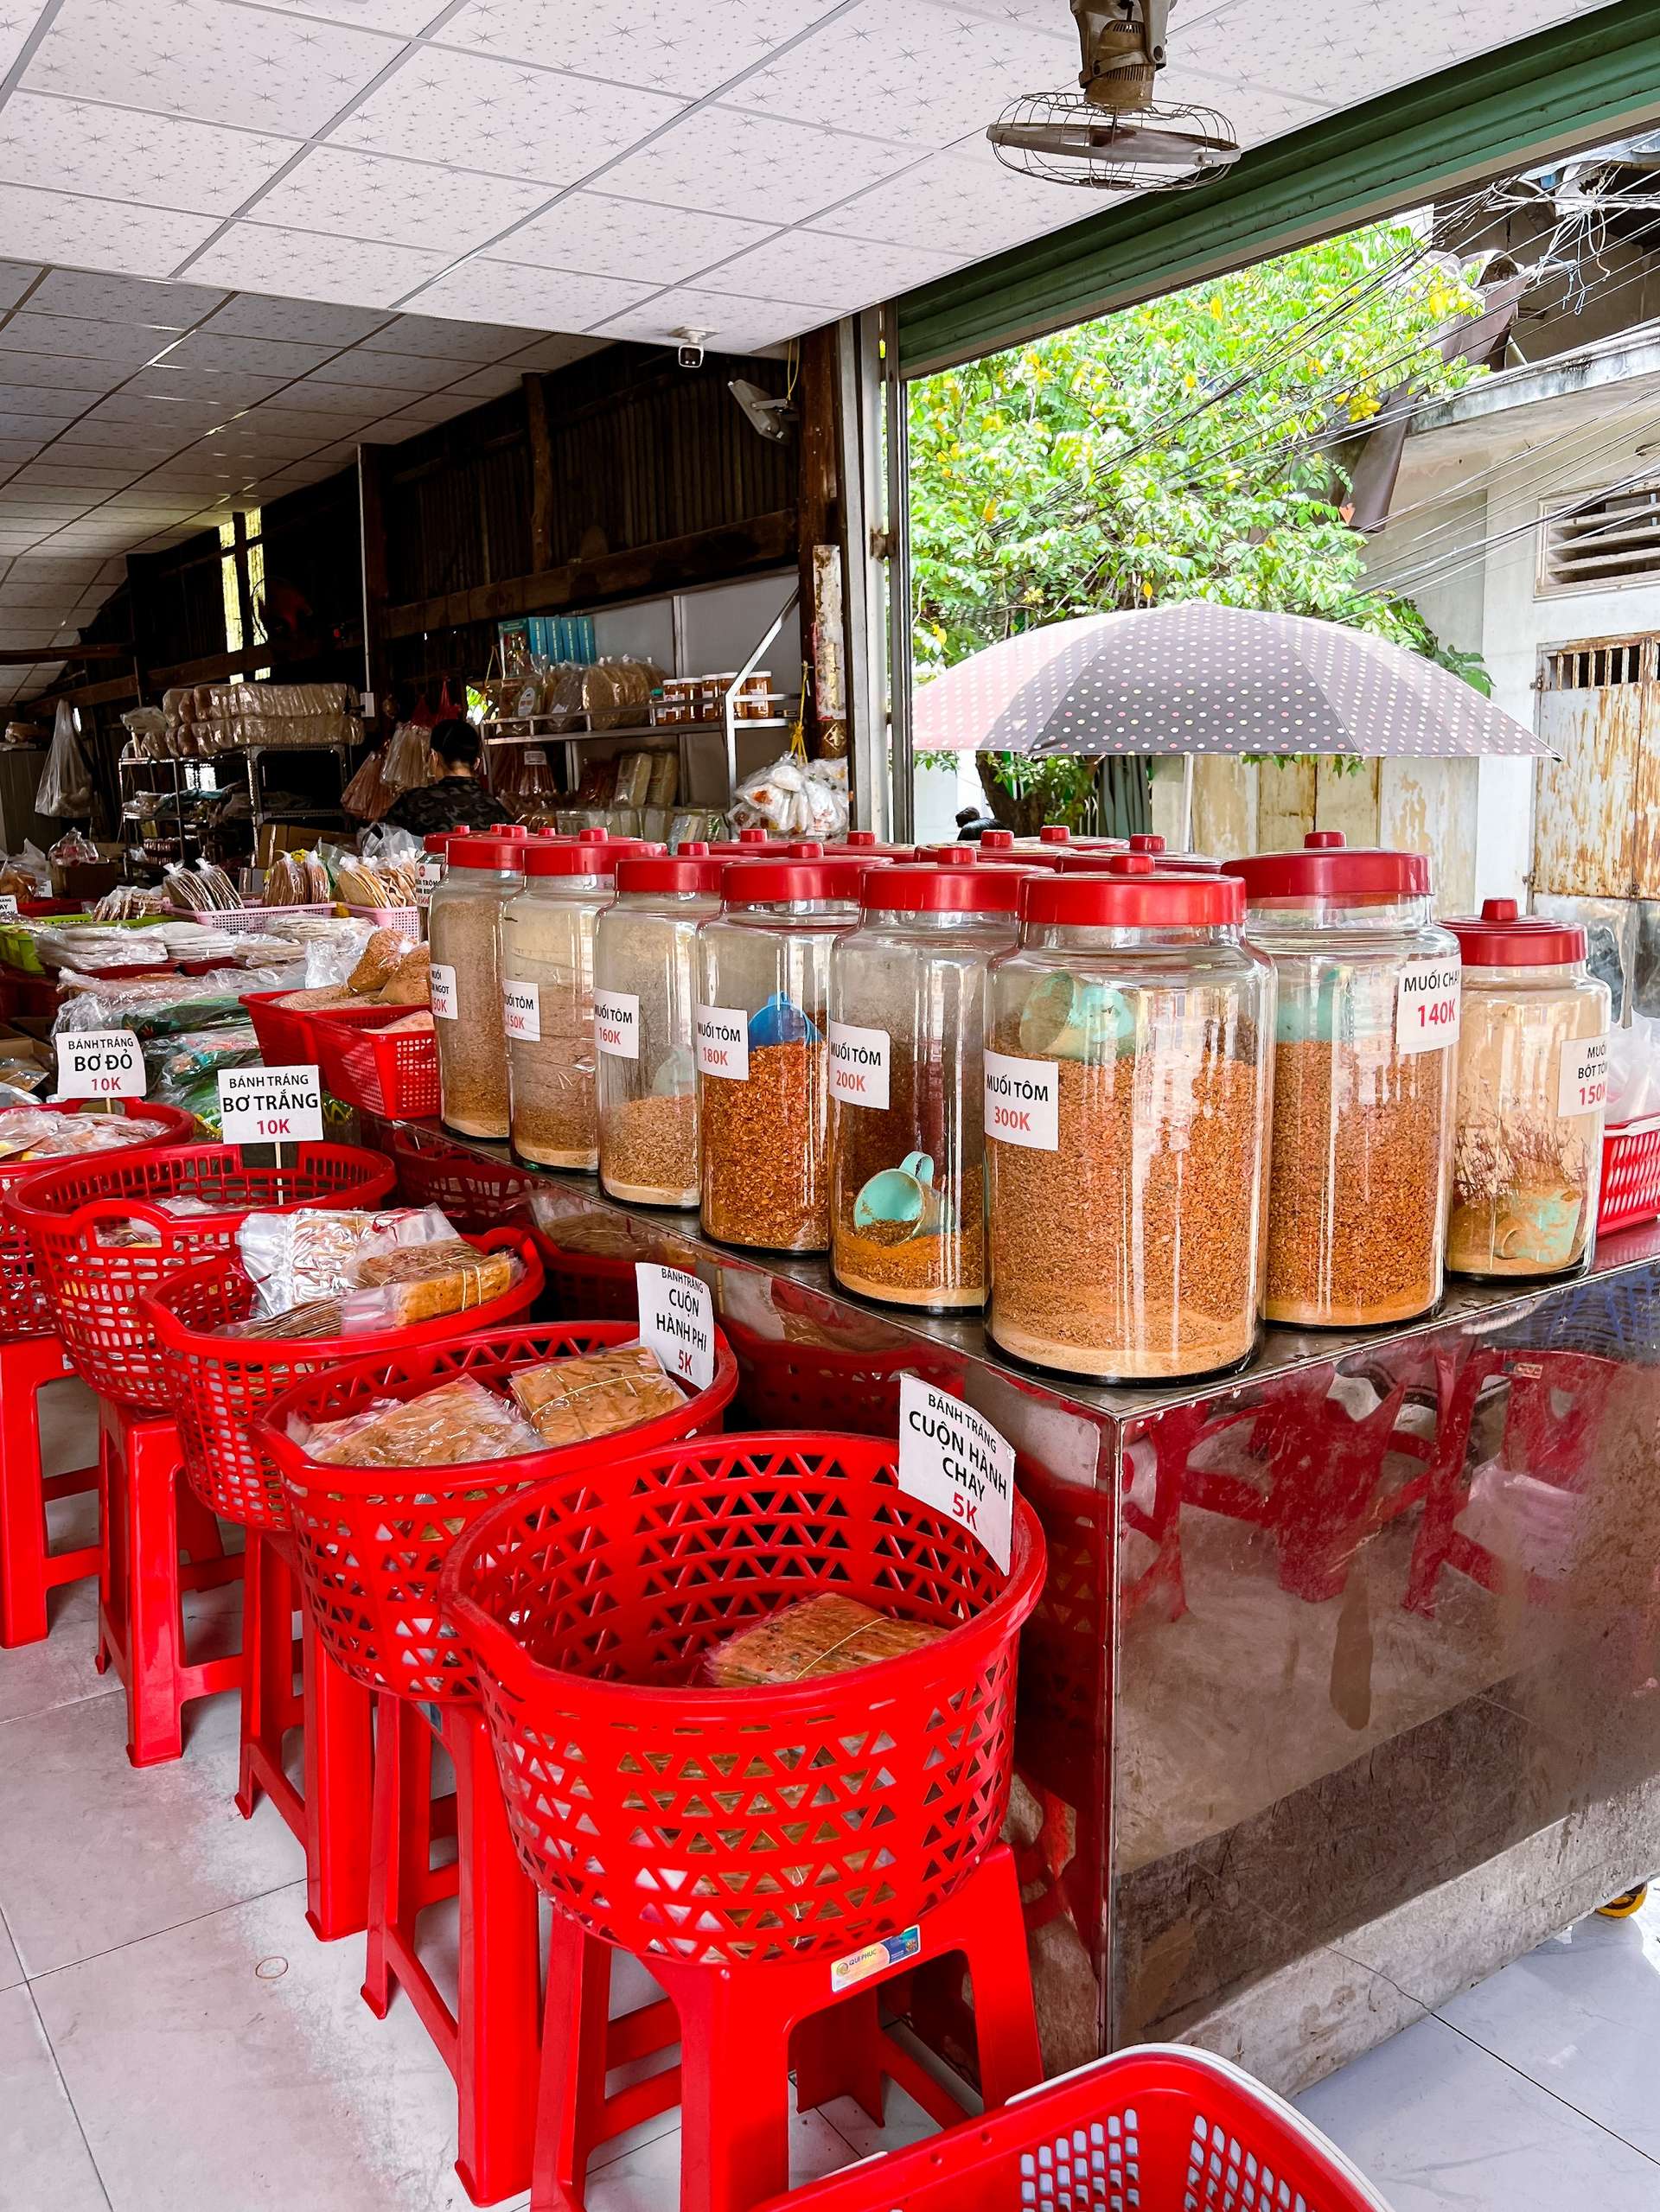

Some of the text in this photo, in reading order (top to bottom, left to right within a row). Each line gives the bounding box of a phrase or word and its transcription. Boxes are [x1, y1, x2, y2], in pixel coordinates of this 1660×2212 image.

[1404, 969, 1440, 992] MUỐI
[515, 996, 534, 1010] TÔM
[1417, 998, 1456, 1028] 140K
[610, 1008, 633, 1023] TÔM
[68, 1036, 134, 1050] BÁNH TRÁNG
[599, 1027, 621, 1045] 160K
[698, 1021, 741, 1042] MUỐI TÔM
[74, 1049, 132, 1072] BƠ ĐỎ
[703, 1047, 728, 1066] 180K
[831, 1042, 881, 1066] MUỐI TÔM
[229, 1073, 309, 1088] BÁNH TRÁNG
[836, 1069, 866, 1092] 200K
[1578, 1063, 1597, 1081] BỘT
[91, 1077, 121, 1091] 10K
[986, 1074, 1049, 1102] MUỐI TÔM
[222, 1088, 318, 1112] BƠ TRẮNG
[256, 1119, 290, 1135] 10K
[994, 1106, 1031, 1131] 300K
[661, 1267, 704, 1294] BÁNH TRÁNG
[668, 1288, 699, 1317] CUỘN
[656, 1312, 707, 1353] HÀNH PHI
[678, 1348, 693, 1376] 5K
[928, 1393, 997, 1454] BÁNH TRÁNG
[909, 1411, 1007, 1501] CUỘN HÀNH
[942, 1457, 986, 1502] CHAY
[952, 1492, 978, 1532] 5K
